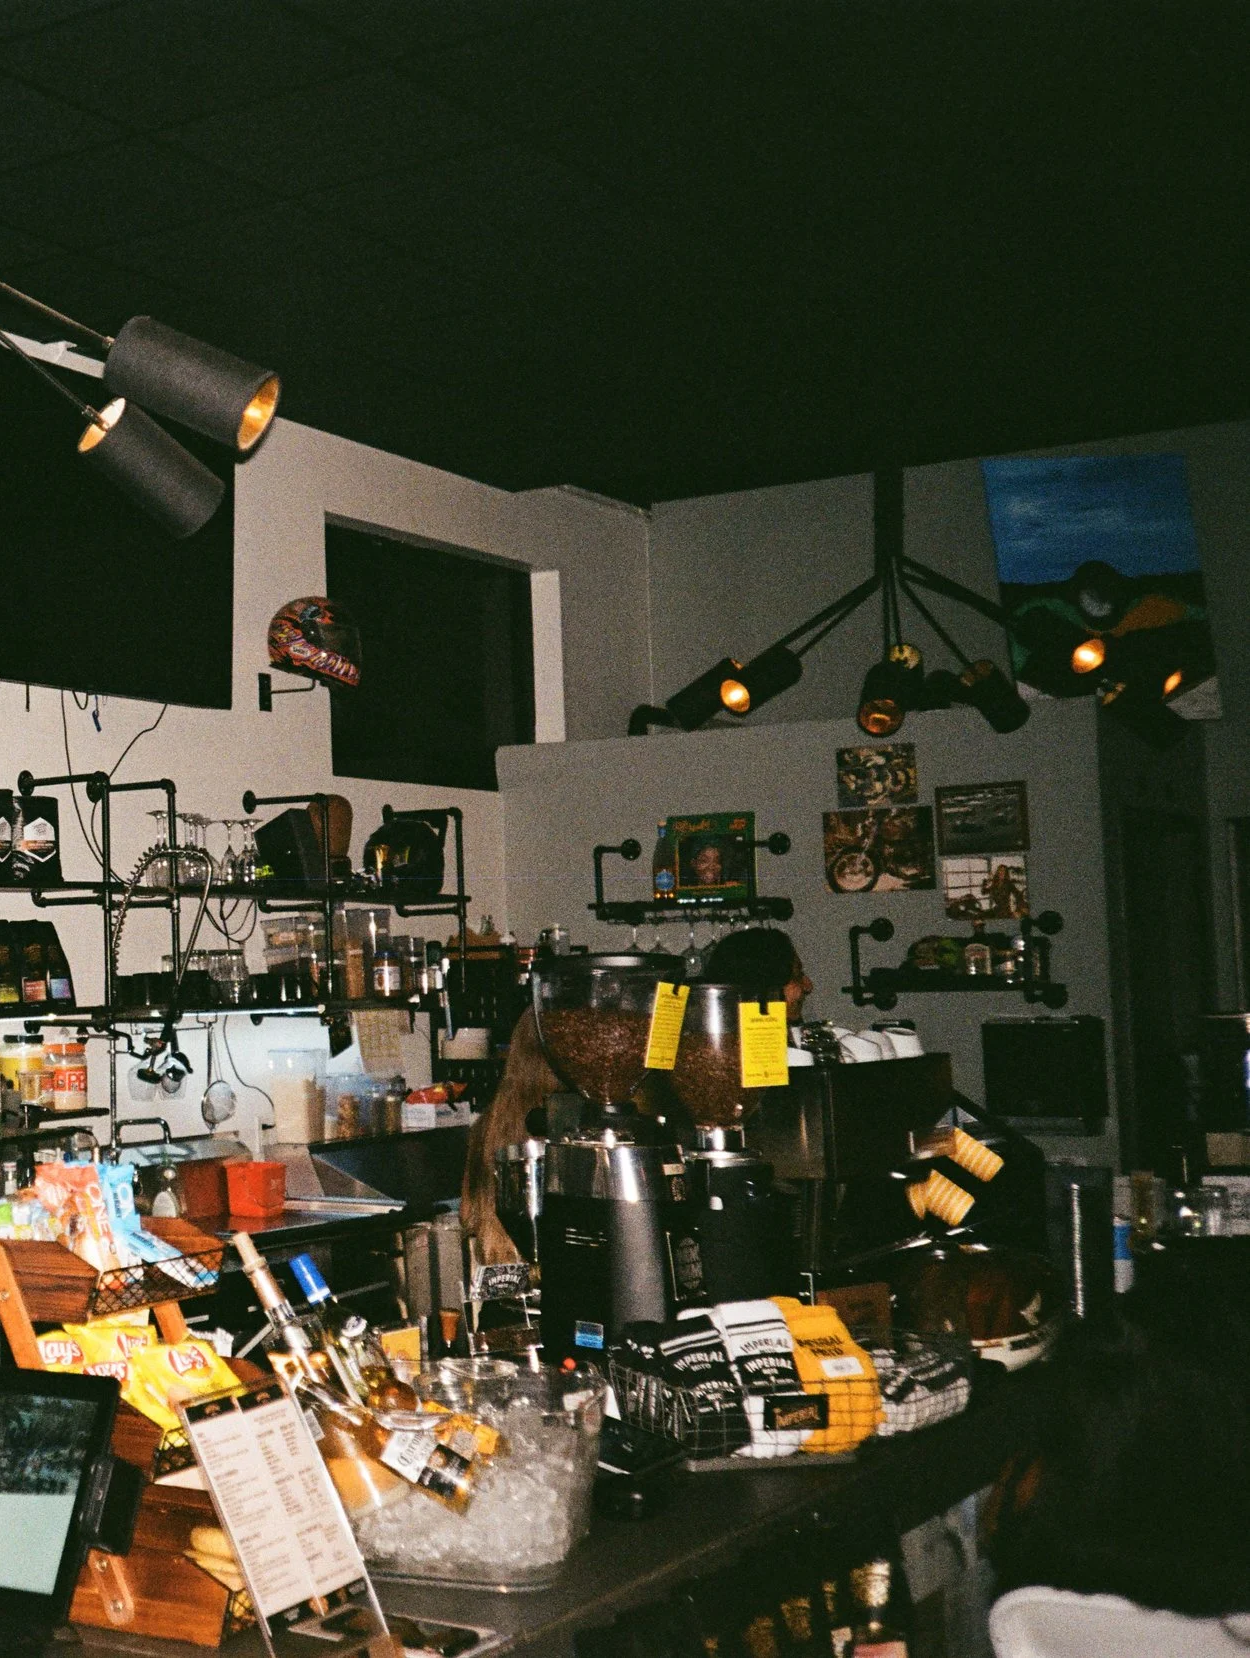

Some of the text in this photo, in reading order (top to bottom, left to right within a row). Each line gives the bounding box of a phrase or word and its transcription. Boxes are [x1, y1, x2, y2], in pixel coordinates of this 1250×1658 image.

[86, 1183, 114, 1243] ONE
[488, 1274, 521, 1286] IMPERIAL
[740, 1338, 790, 1353] IMPERIAL
[795, 1335, 843, 1347] IMPERIAL
[673, 1351, 725, 1371] IMPERIAL
[744, 1357, 793, 1373] IMPERIAL
